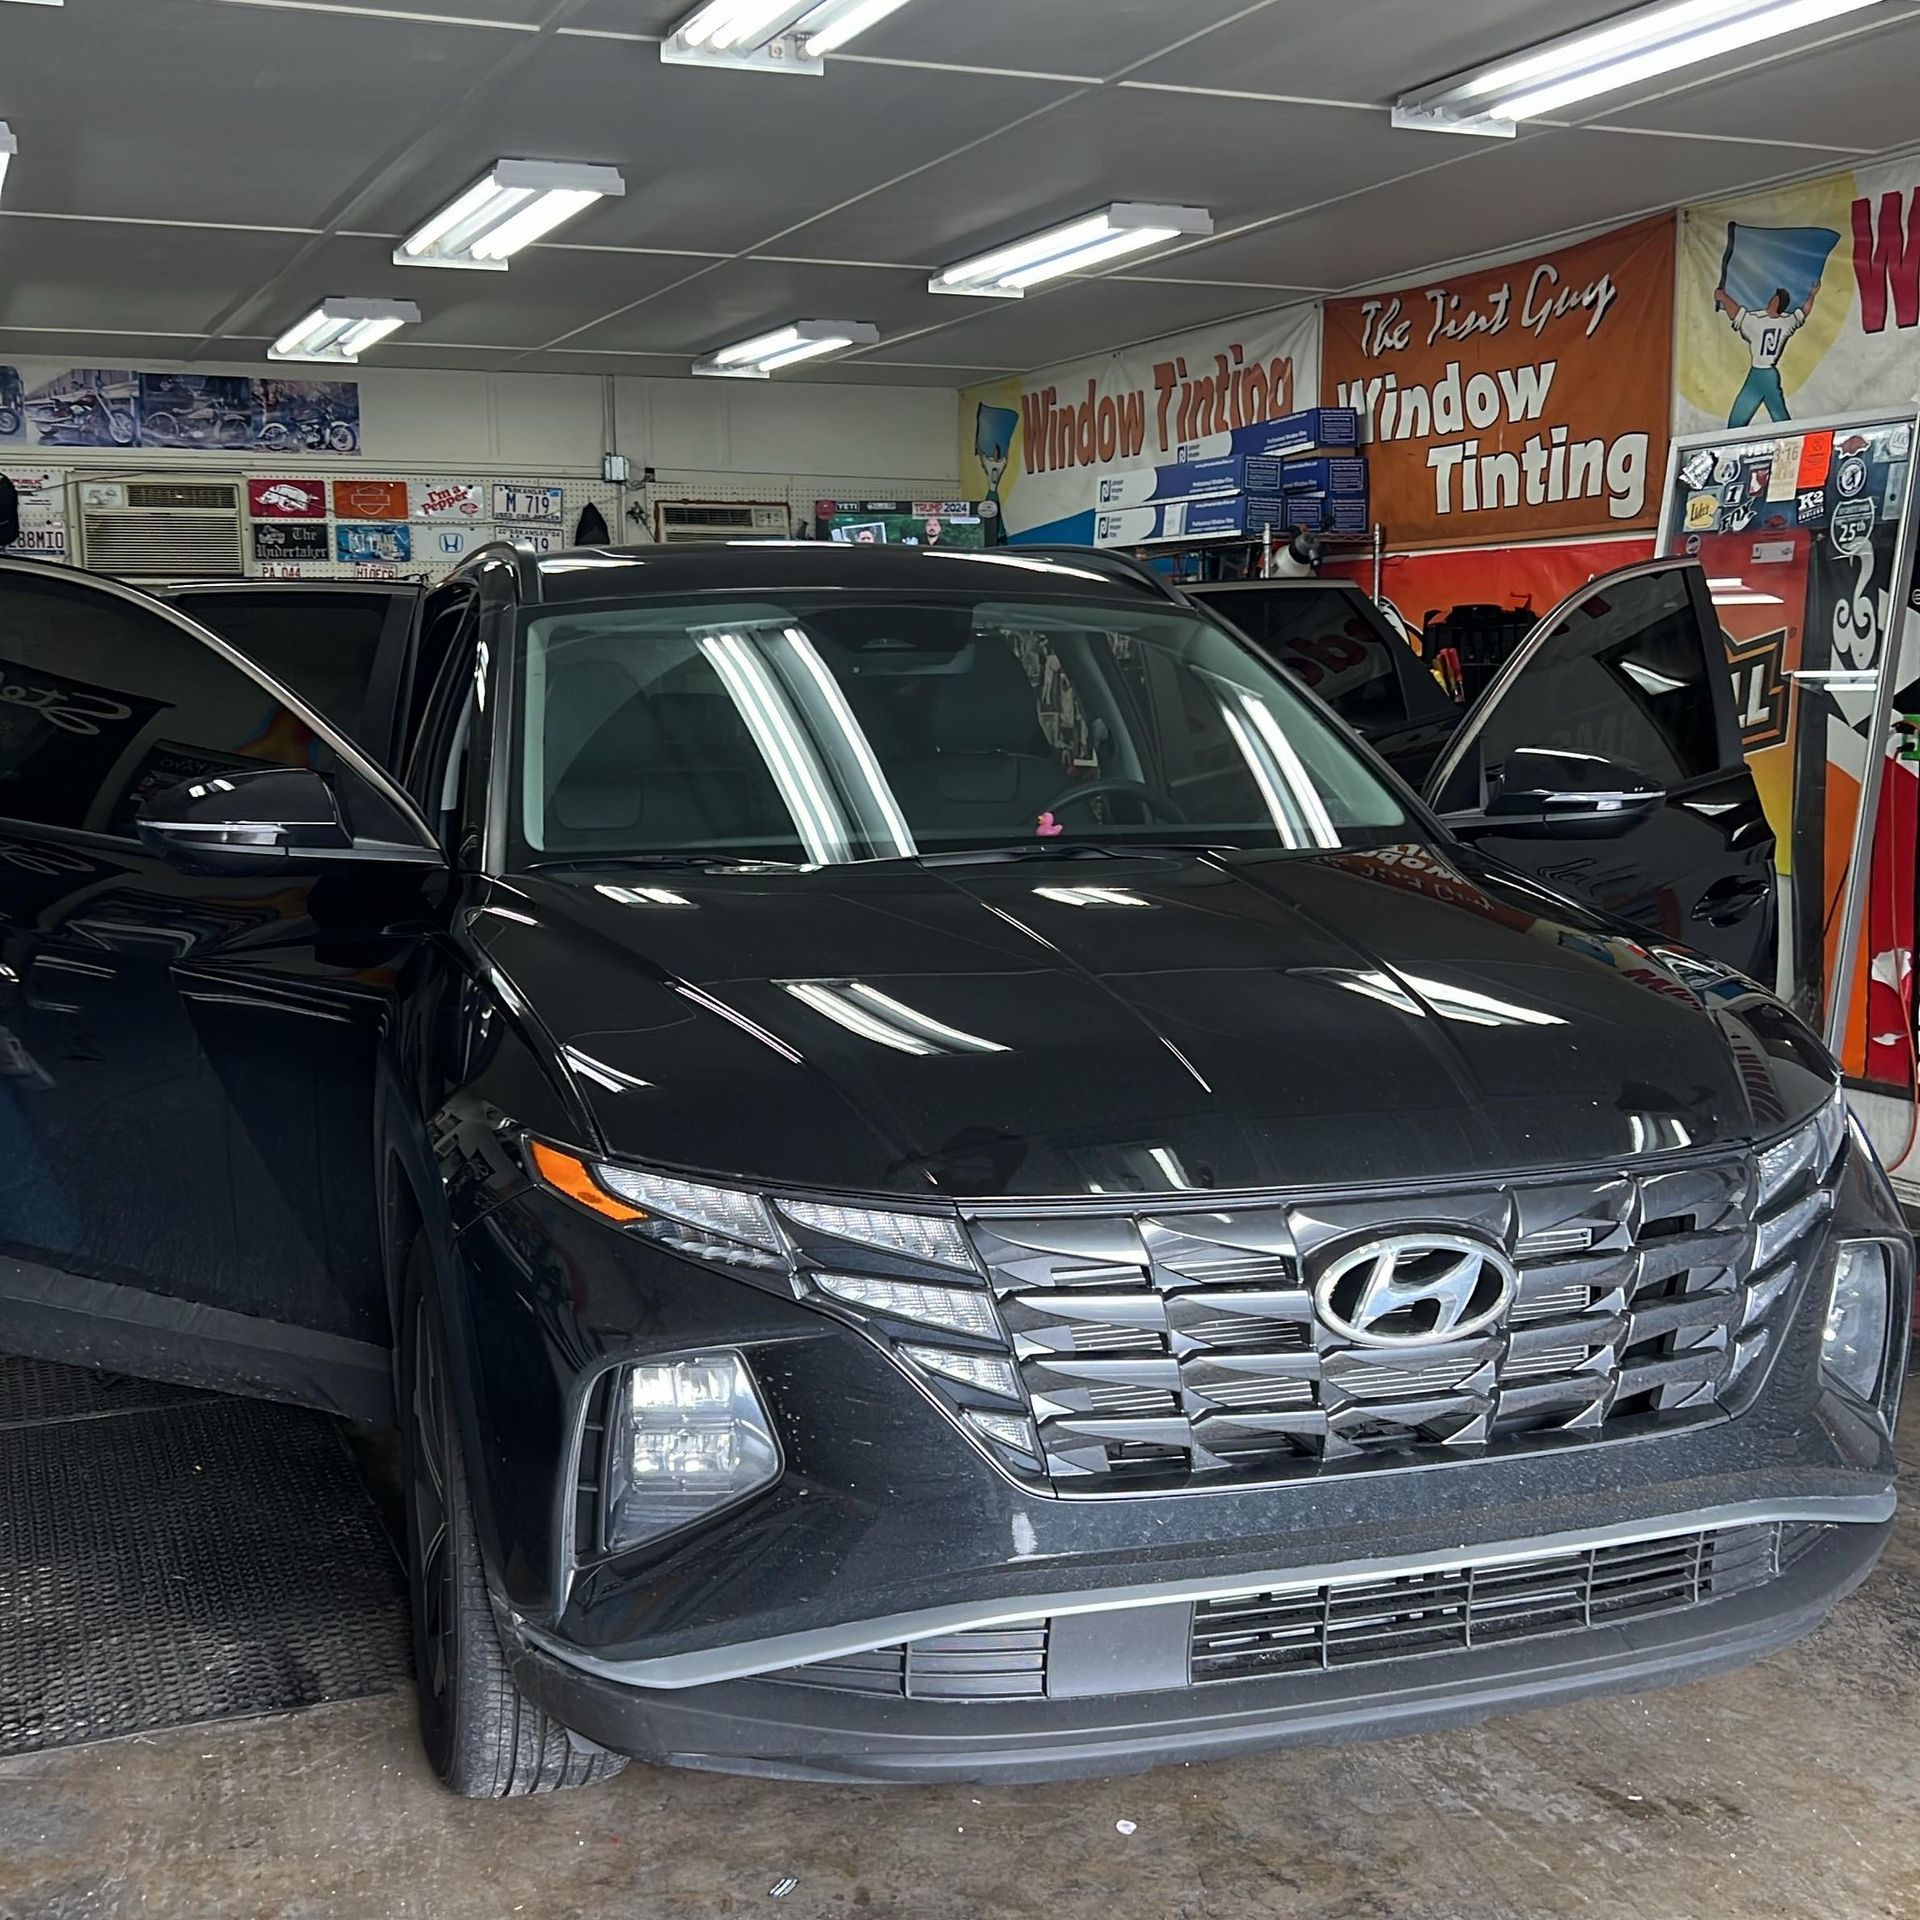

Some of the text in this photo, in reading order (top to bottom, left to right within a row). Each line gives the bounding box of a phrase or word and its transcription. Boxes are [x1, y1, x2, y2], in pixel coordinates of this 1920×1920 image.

[1361, 263, 1616, 357] The Tint Guy
[1337, 360, 1557, 444] Window
[1021, 378, 1145, 474] Window
[1426, 425, 1649, 519] Tinting
[421, 490, 468, 515] Pepper
[428, 485, 461, 503] I'm a
[506, 493, 549, 514] M 719
[914, 503, 967, 512] TRUMP 2024
[292, 526, 317, 541] The
[1838, 520, 1866, 542] 25th
[256, 544, 327, 559] Undertaker
